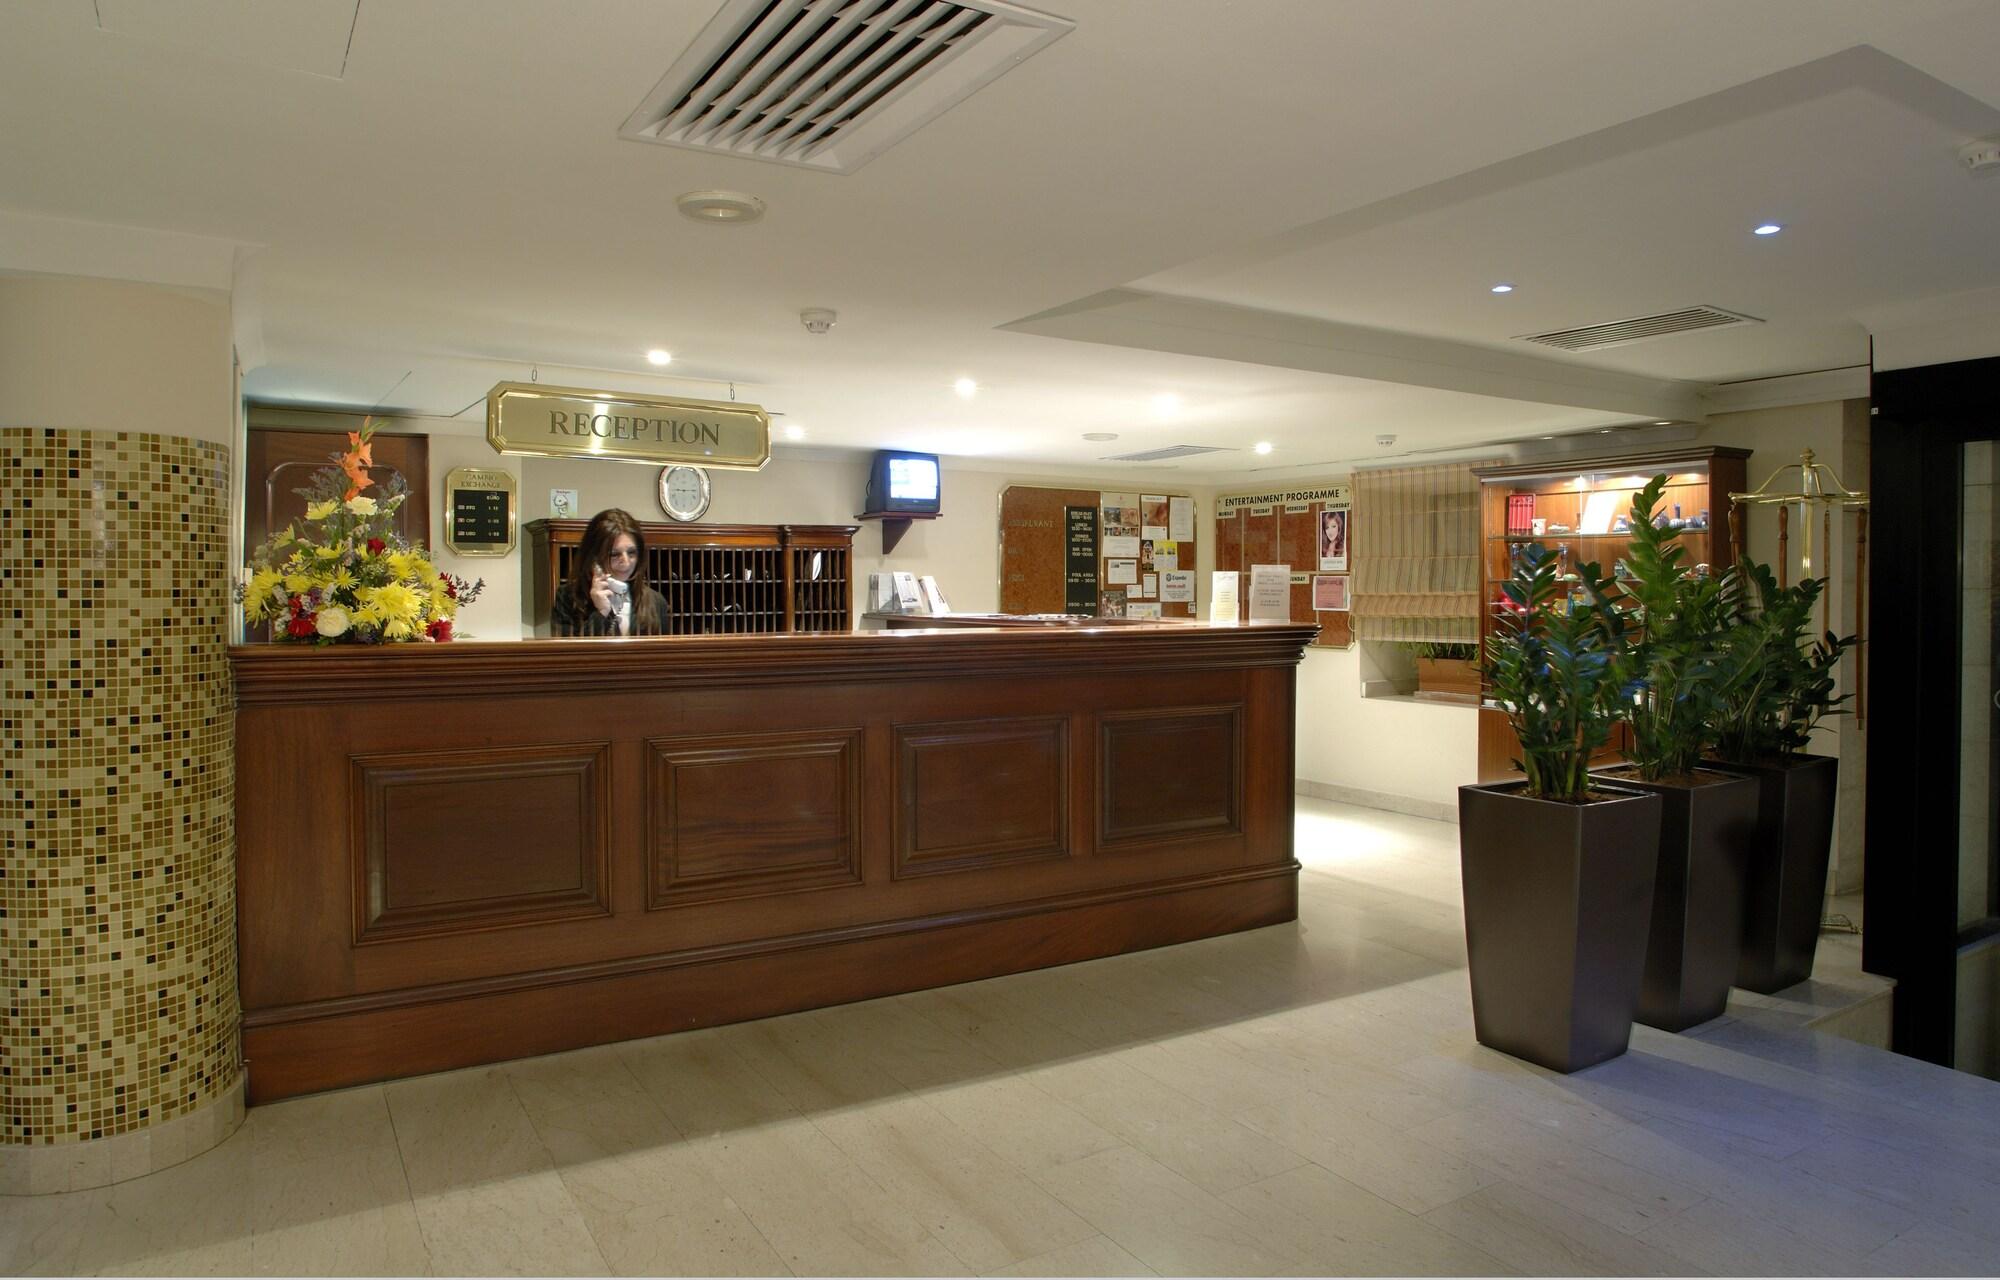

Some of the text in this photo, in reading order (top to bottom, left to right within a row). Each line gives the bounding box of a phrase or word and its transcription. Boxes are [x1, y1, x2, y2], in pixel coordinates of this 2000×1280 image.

[549, 410, 721, 446] RECEPTION
[461, 480, 500, 488] EXCHANGE
[1225, 489, 1340, 507] ENTERTAINMENT PROGRAMME
